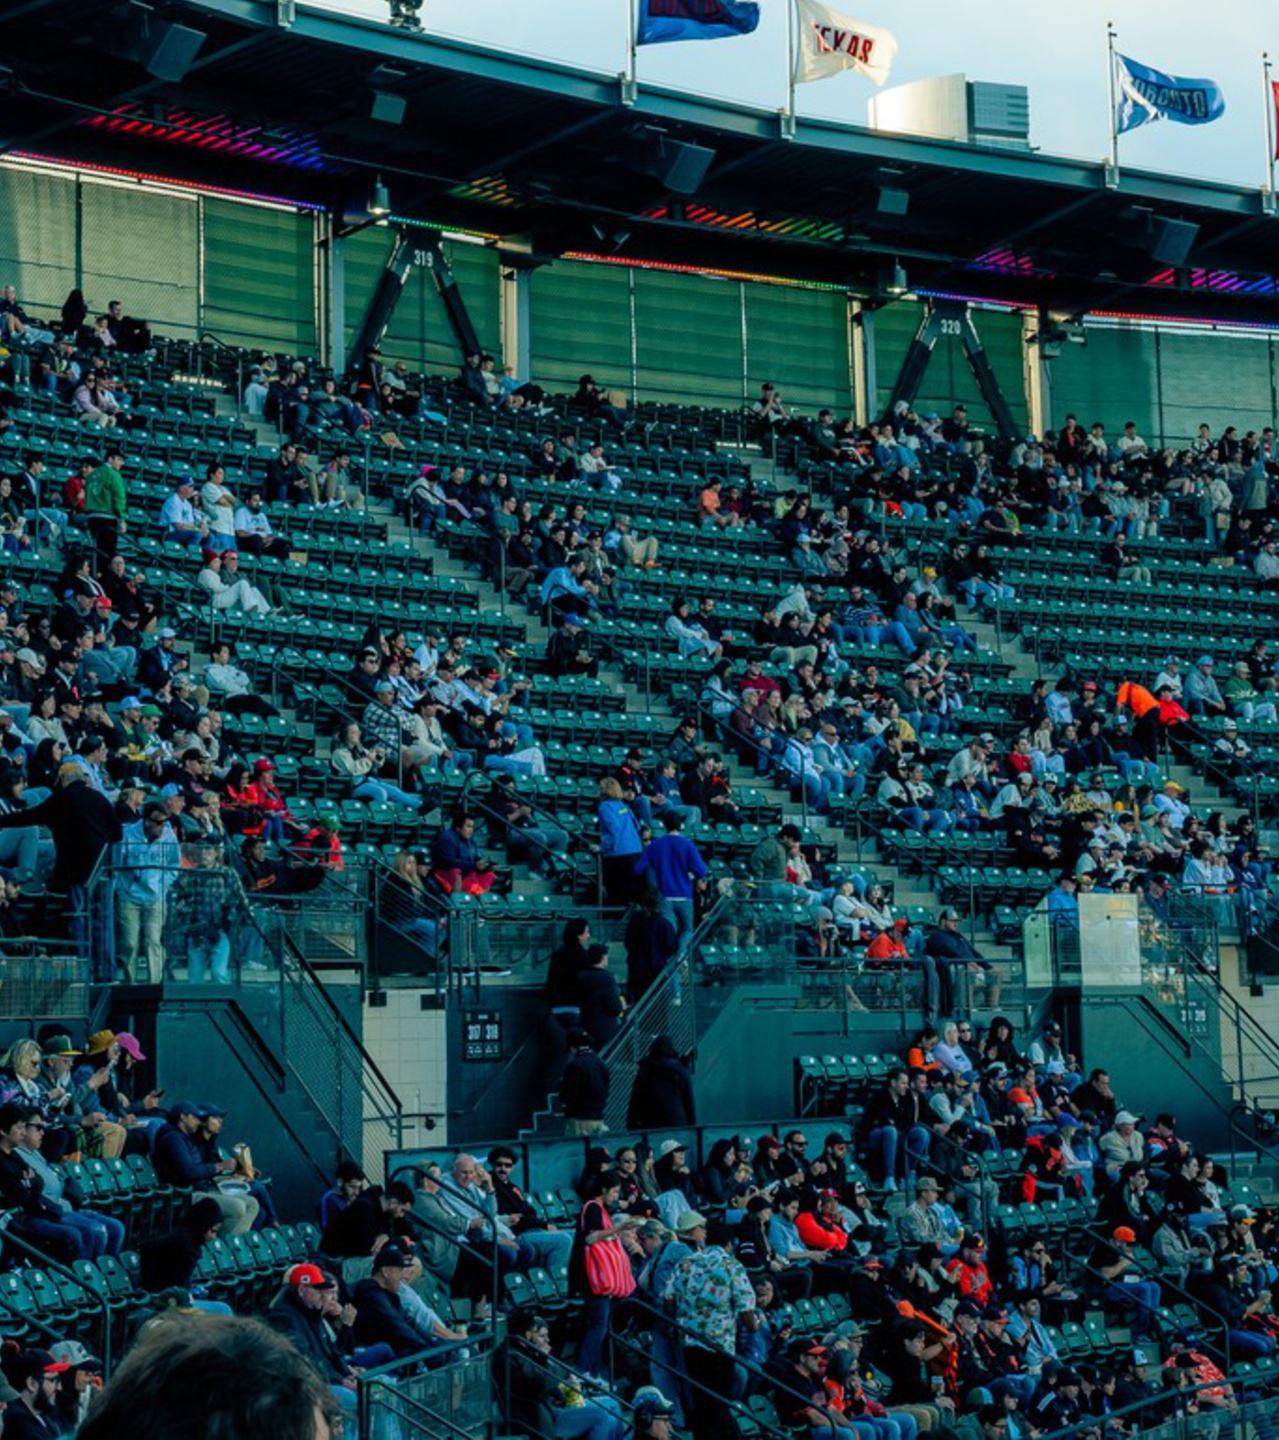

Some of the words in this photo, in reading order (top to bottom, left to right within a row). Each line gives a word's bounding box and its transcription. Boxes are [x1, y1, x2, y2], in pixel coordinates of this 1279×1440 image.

[1135, 78, 1205, 119] ORONTO
[414, 249, 433, 267] 319
[940, 318, 961, 335] 320
